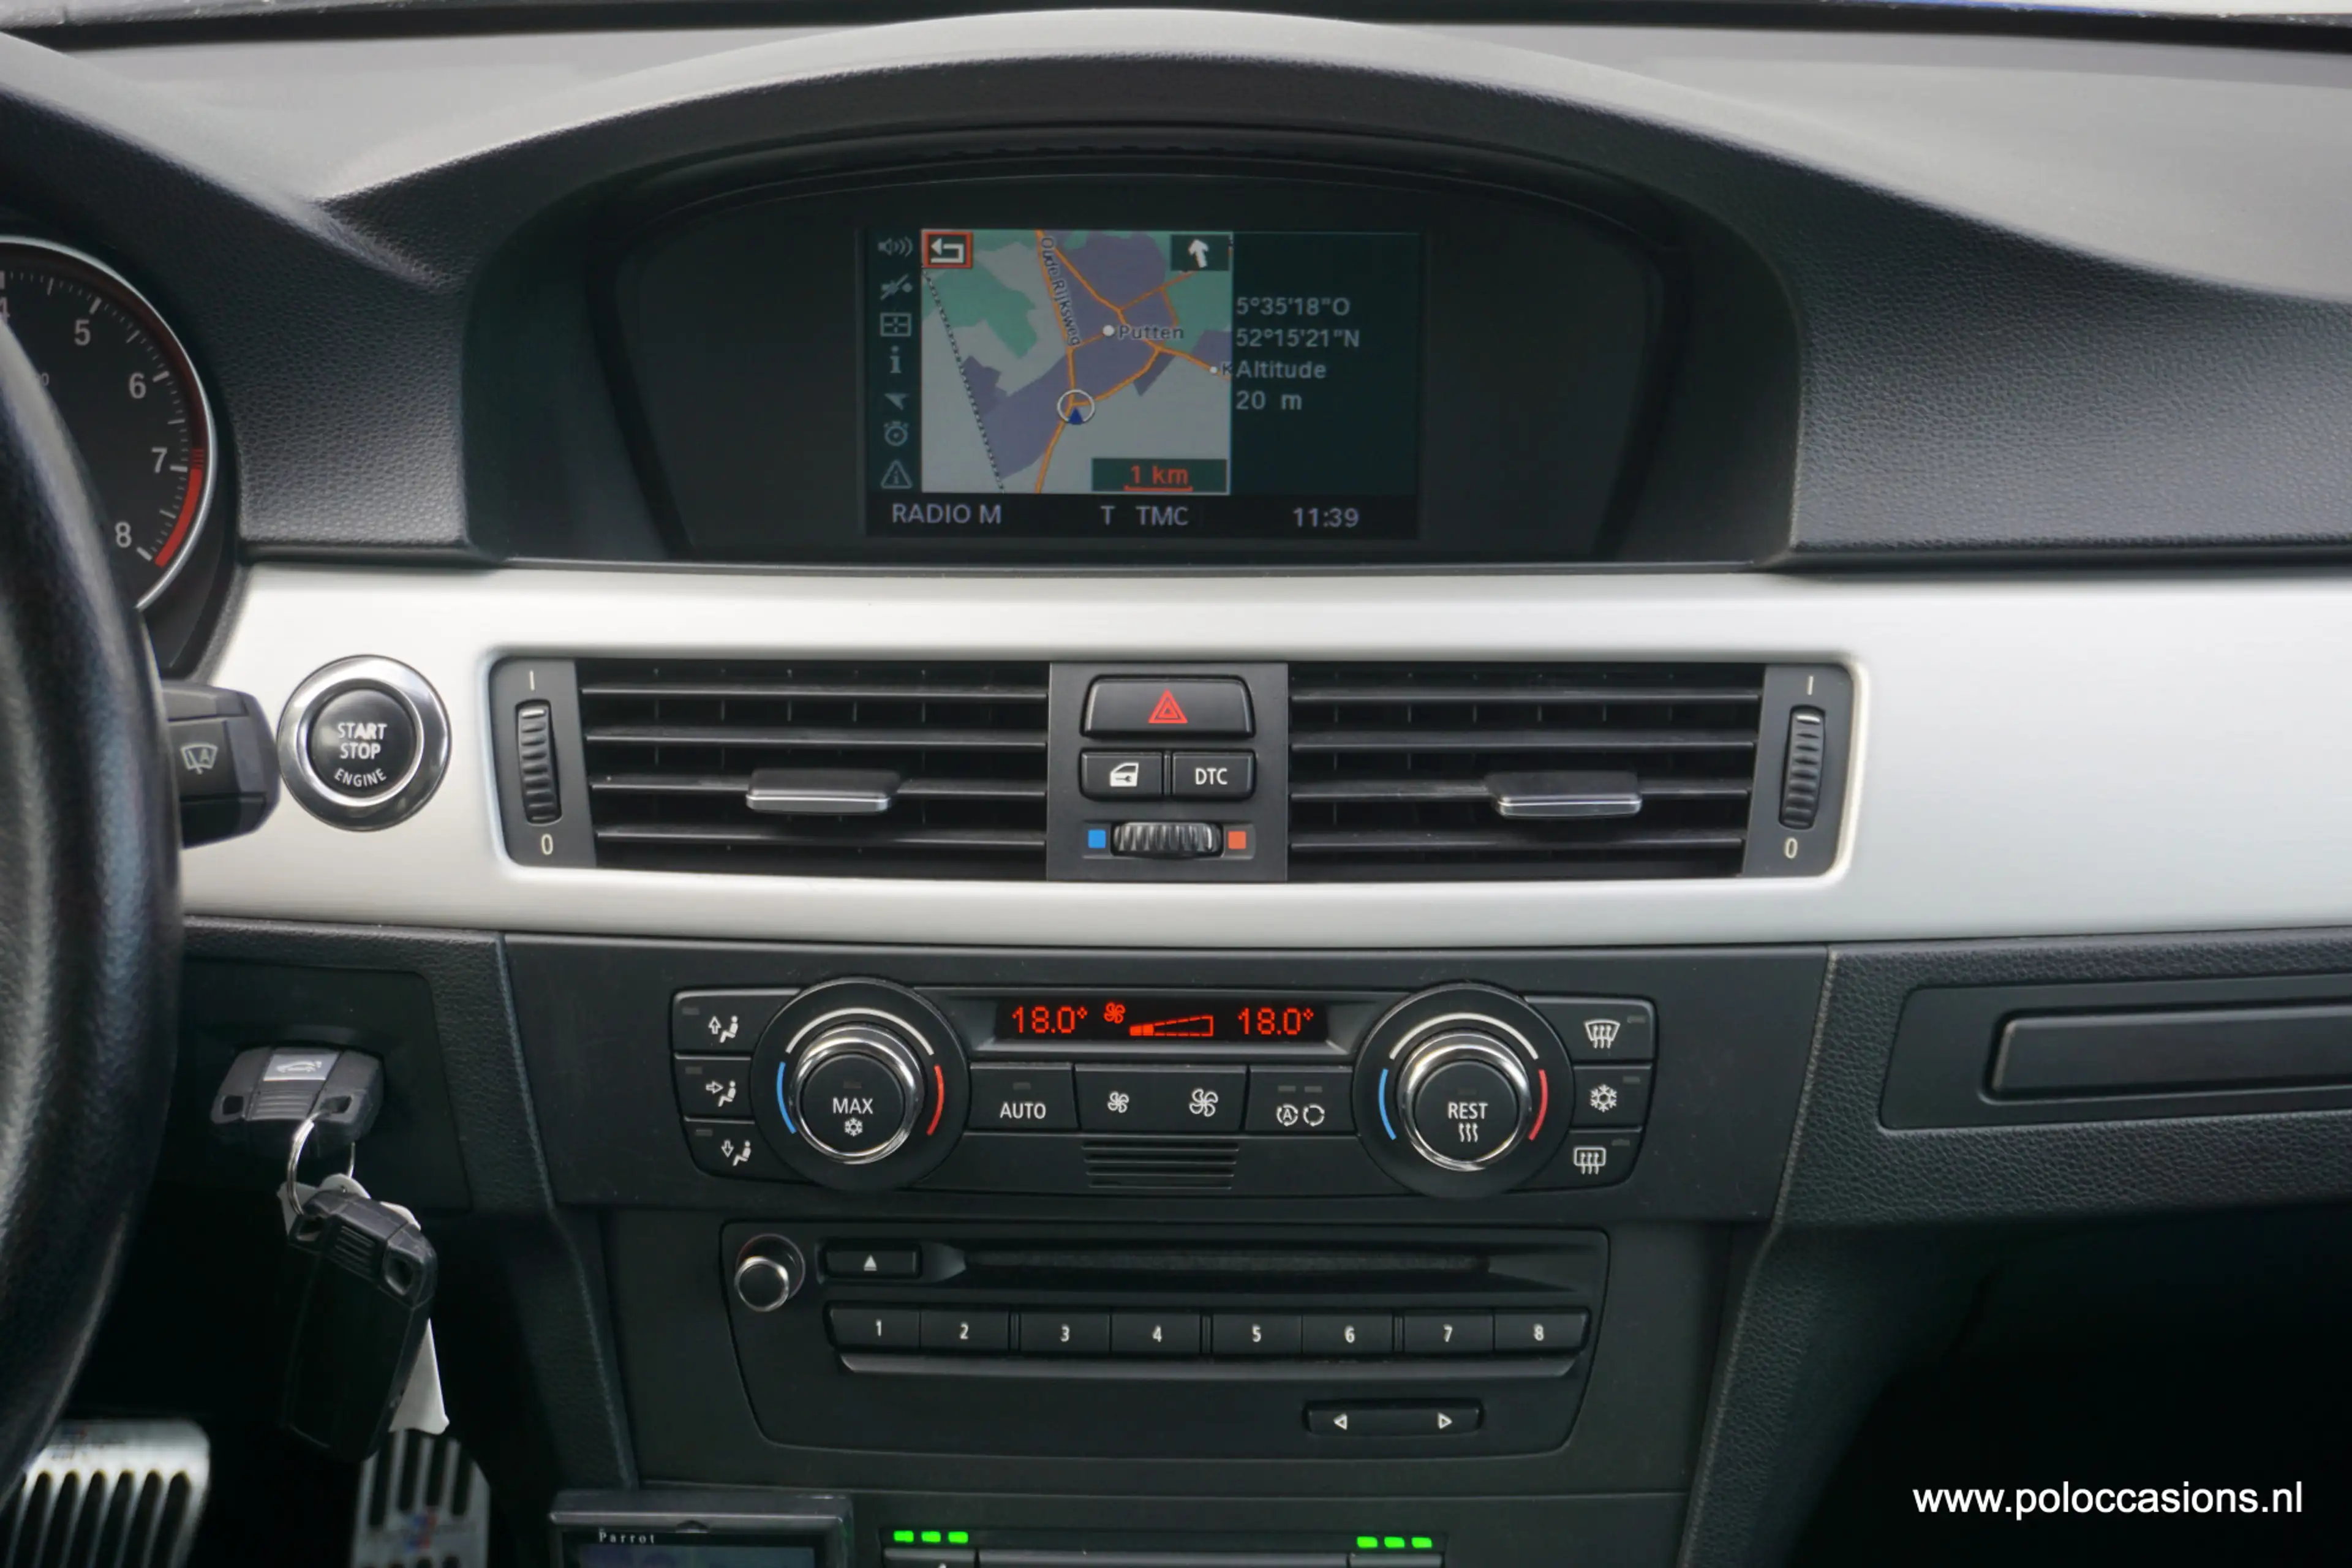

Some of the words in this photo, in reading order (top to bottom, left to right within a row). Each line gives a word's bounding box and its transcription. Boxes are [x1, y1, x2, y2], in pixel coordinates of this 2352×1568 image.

[1042, 238, 1058, 276] Oude
[74, 320, 91, 345] 5
[1119, 324, 1184, 341] Putten
[1236, 361, 1327, 379] Altitude
[129, 373, 146, 398] 6
[1236, 391, 1267, 410] 20
[1281, 396, 1302, 410] m
[151, 448, 168, 473] 7
[1131, 466, 1140, 484] 1
[1152, 466, 1188, 484] km
[892, 503, 971, 525] RADIO
[980, 504, 1001, 525] M
[1101, 506, 1115, 525] T
[1136, 506, 1189, 526] TMC
[1293, 507, 1359, 528] 11:39
[115, 522, 132, 548] 8
[337, 723, 387, 739] START
[341, 743, 381, 760] STOP
[334, 767, 387, 787] ENGINE
[1195, 767, 1228, 785] DTC
[832, 1098, 873, 1115] MAX
[1000, 1101, 1046, 1120] AUTO
[1448, 1102, 1488, 1120] REST
[875, 1321, 882, 1336] 1
[960, 1323, 969, 1340] 2
[1060, 1325, 1071, 1342] 3
[1152, 1326, 1163, 1342] 4
[1251, 1325, 1262, 1342] 5
[1344, 1325, 1355, 1343] 6
[1443, 1325, 1453, 1342] 7
[1533, 1324, 1544, 1341] 8
[598, 1531, 655, 1544] Parrot
